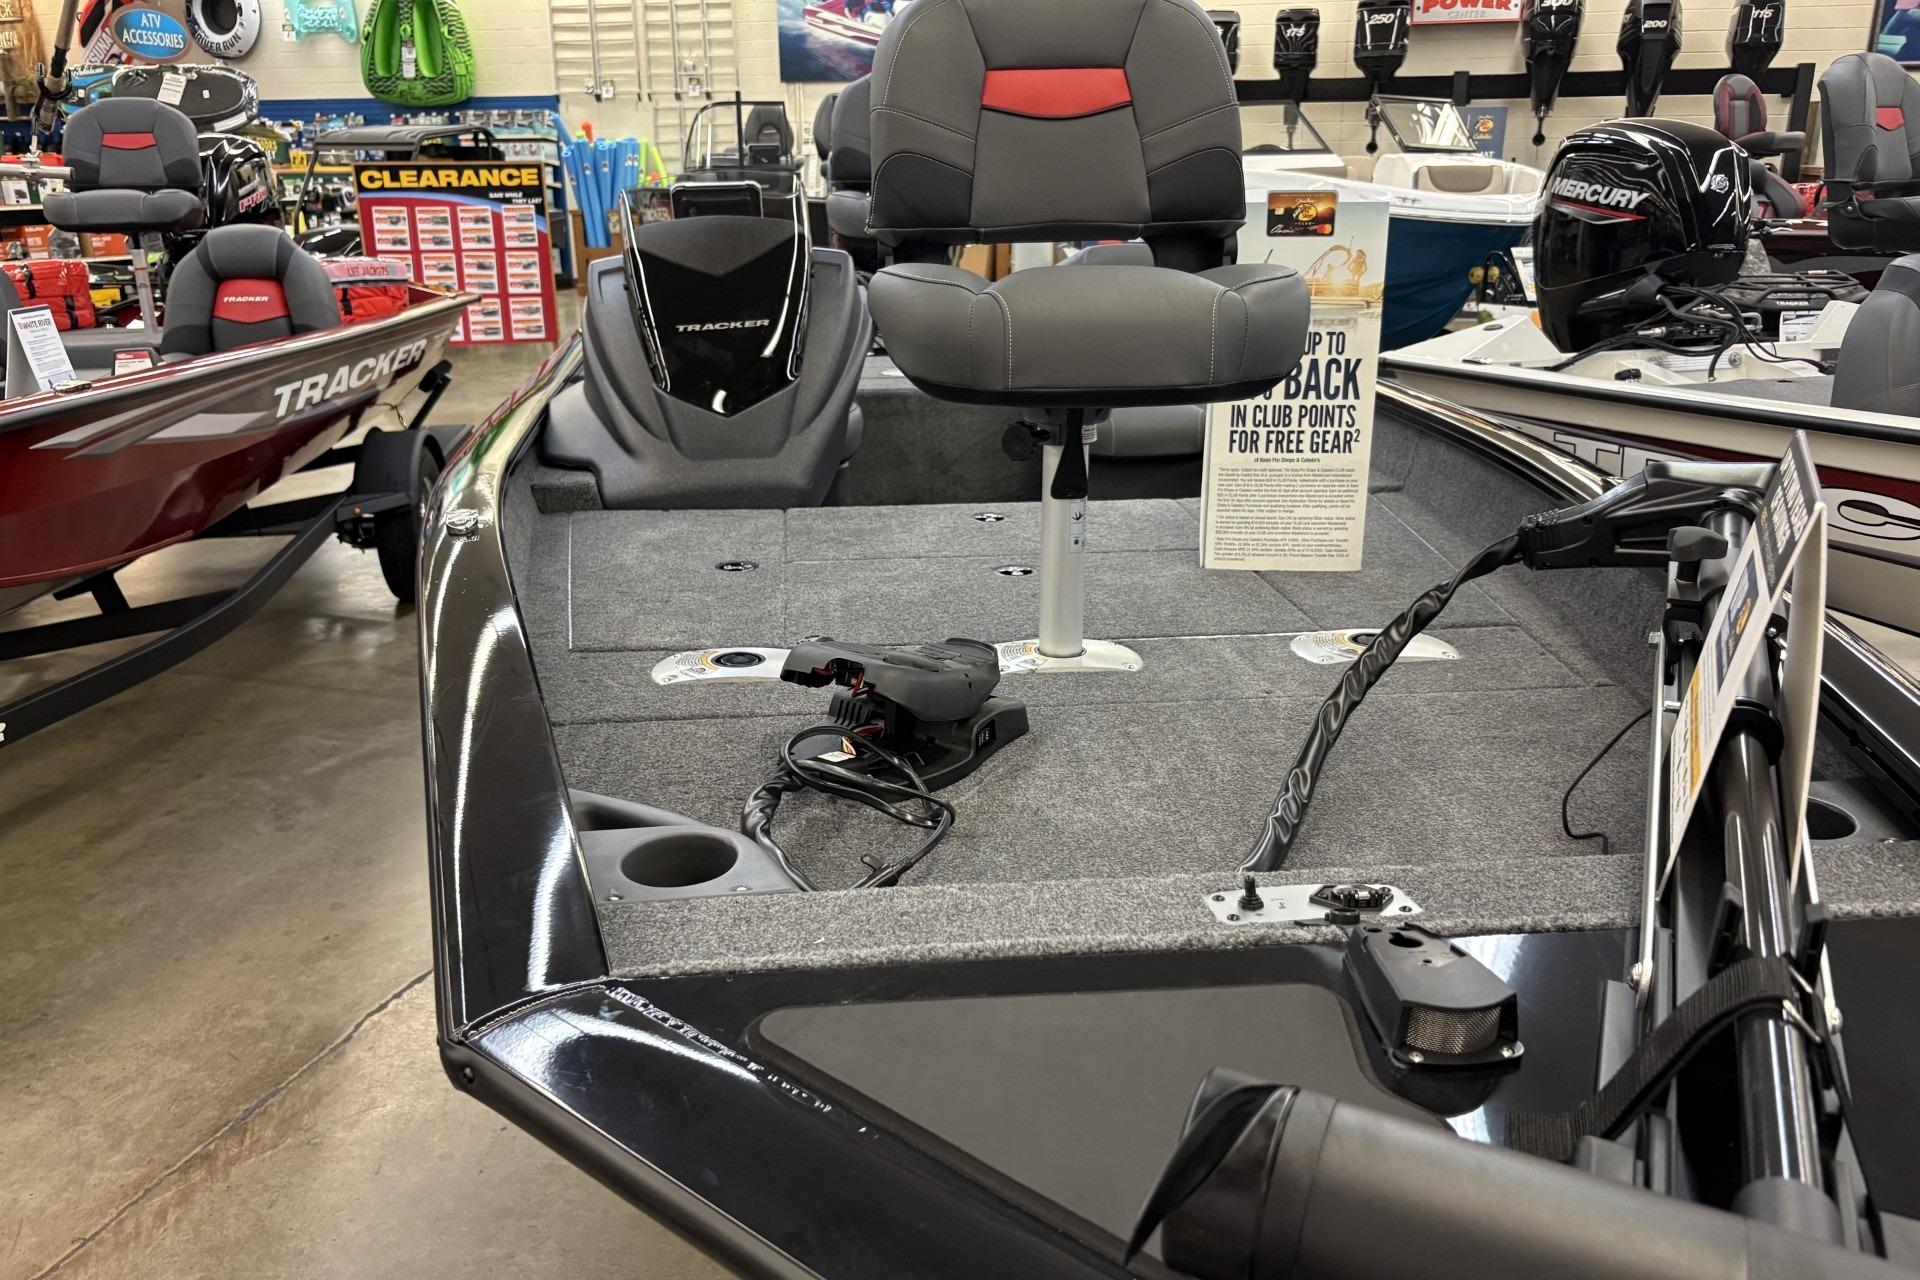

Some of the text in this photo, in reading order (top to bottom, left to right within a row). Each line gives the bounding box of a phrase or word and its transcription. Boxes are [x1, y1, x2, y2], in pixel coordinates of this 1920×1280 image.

[141, 13, 161, 28] ATV
[1368, 13, 1395, 25] 250
[1644, 20, 1668, 28] 200
[1753, 9, 1774, 18] 115
[122, 28, 185, 49] ACCESSORIES
[222, 32, 242, 51] RUN
[360, 168, 540, 189] CLEARANCE
[1551, 177, 1650, 209] MERCURY
[675, 319, 771, 333] TRACKER
[1326, 331, 1346, 355] TO
[273, 338, 428, 418] TRACKER
[1284, 358, 1363, 400] BACK
[1231, 404, 1357, 428] IN CLUB POINTS
[1229, 430, 1260, 454] FOR
[1265, 430, 1305, 454] FREE
